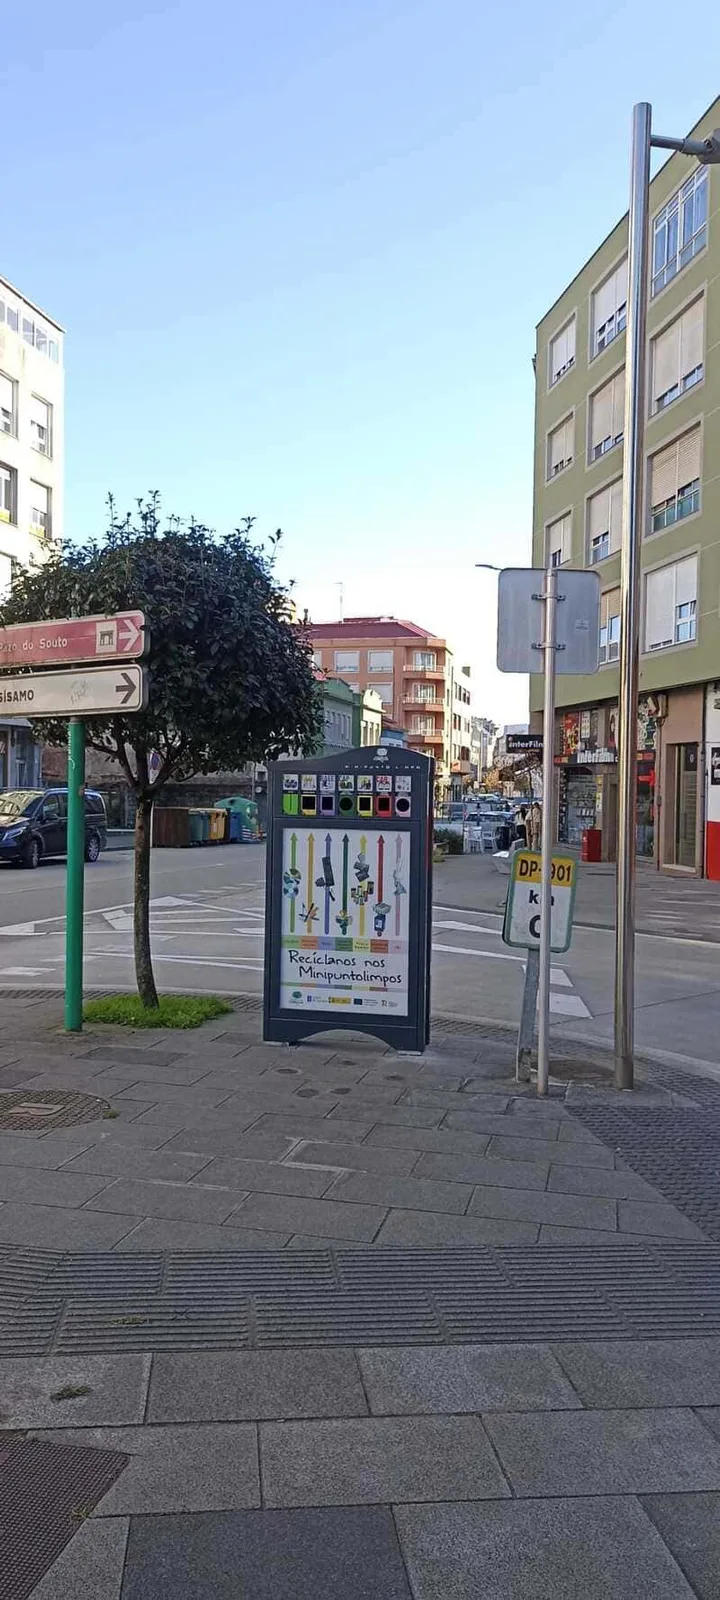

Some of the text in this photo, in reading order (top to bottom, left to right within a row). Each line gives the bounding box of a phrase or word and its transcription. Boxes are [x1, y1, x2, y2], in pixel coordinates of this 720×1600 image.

[22, 640, 34, 650] do
[39, 636, 68, 649] Souto
[288, 949, 386, 968] Recíclanos nos
[298, 966, 402, 988] Minipuntolimpos
